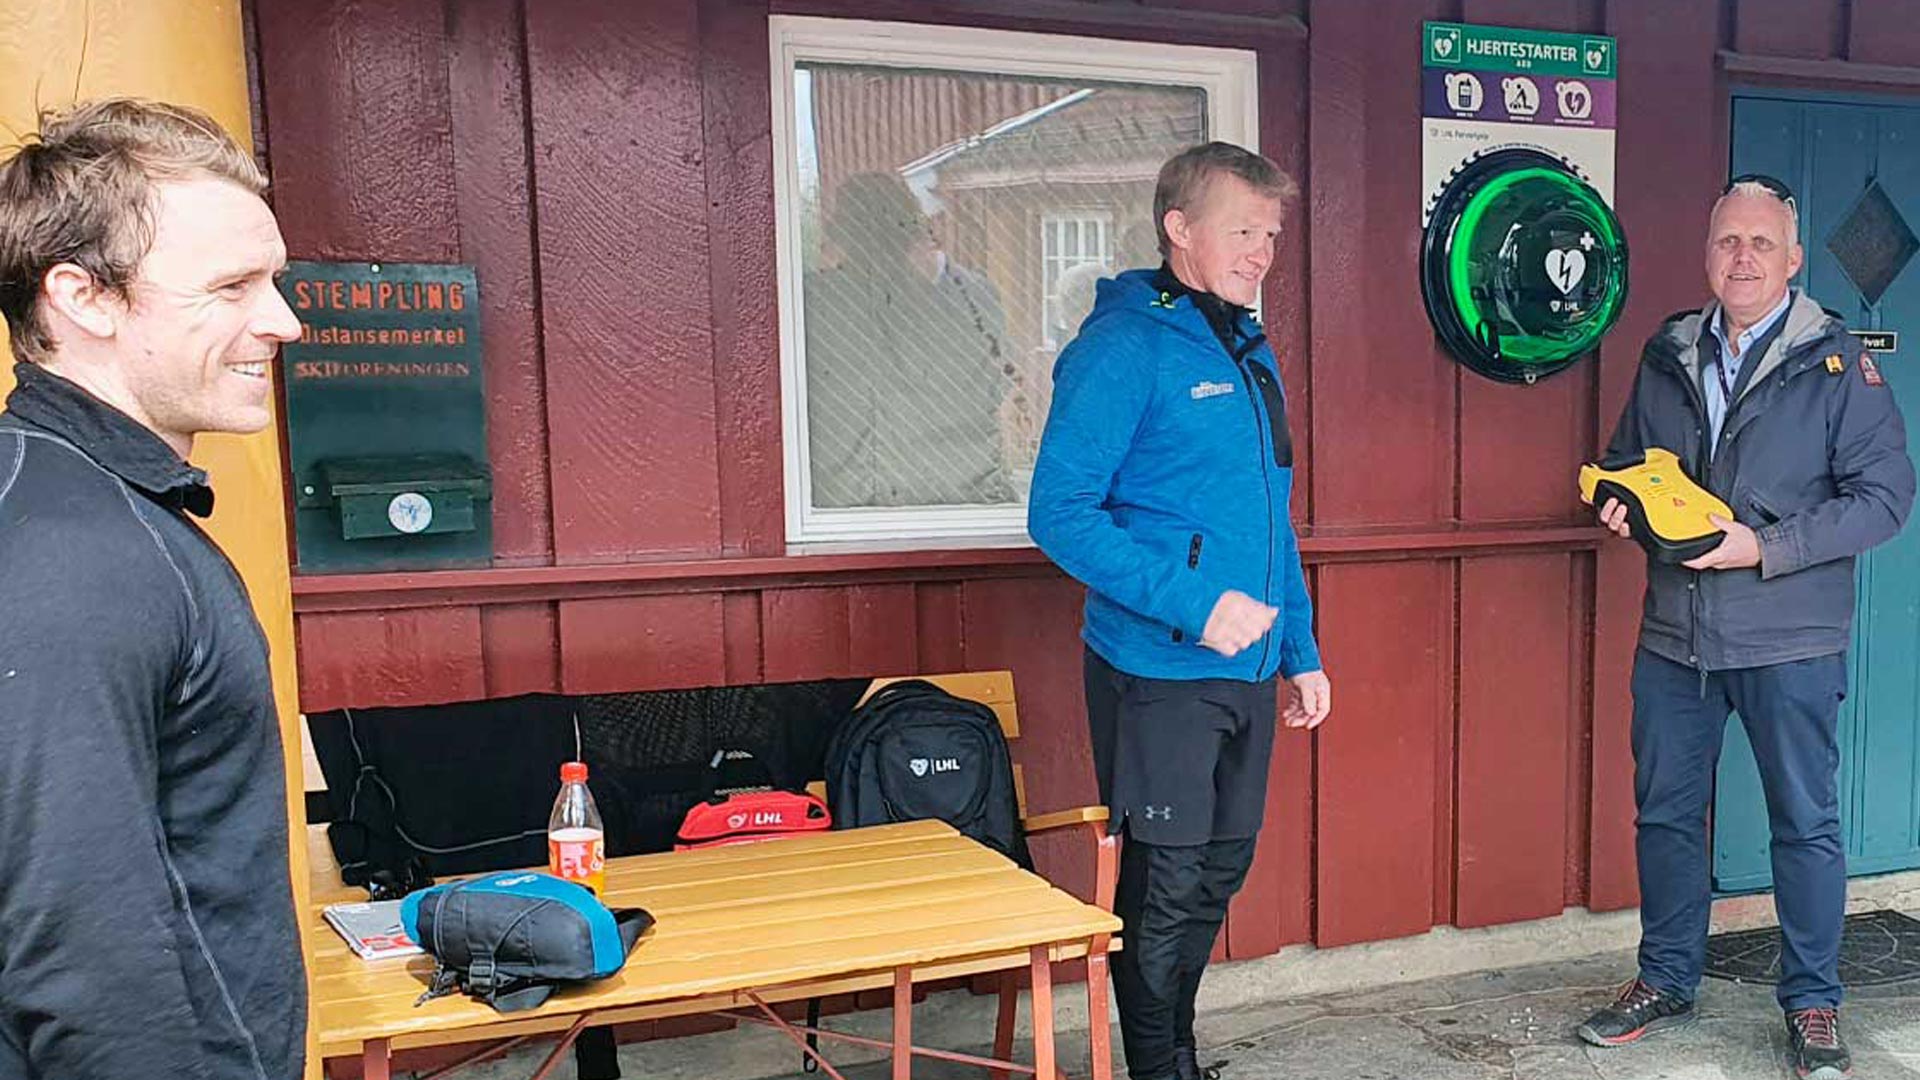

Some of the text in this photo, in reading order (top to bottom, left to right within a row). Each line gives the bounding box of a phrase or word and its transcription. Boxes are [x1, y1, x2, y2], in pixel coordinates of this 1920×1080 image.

[1466, 39, 1577, 61] HJERTESTARTER
[295, 280, 464, 310] STEMPLING
[1861, 336, 1885, 348] ivat
[296, 362, 469, 378] SKIFORENINGEN
[935, 758, 960, 772] LHL
[755, 812, 783, 824] LHL
